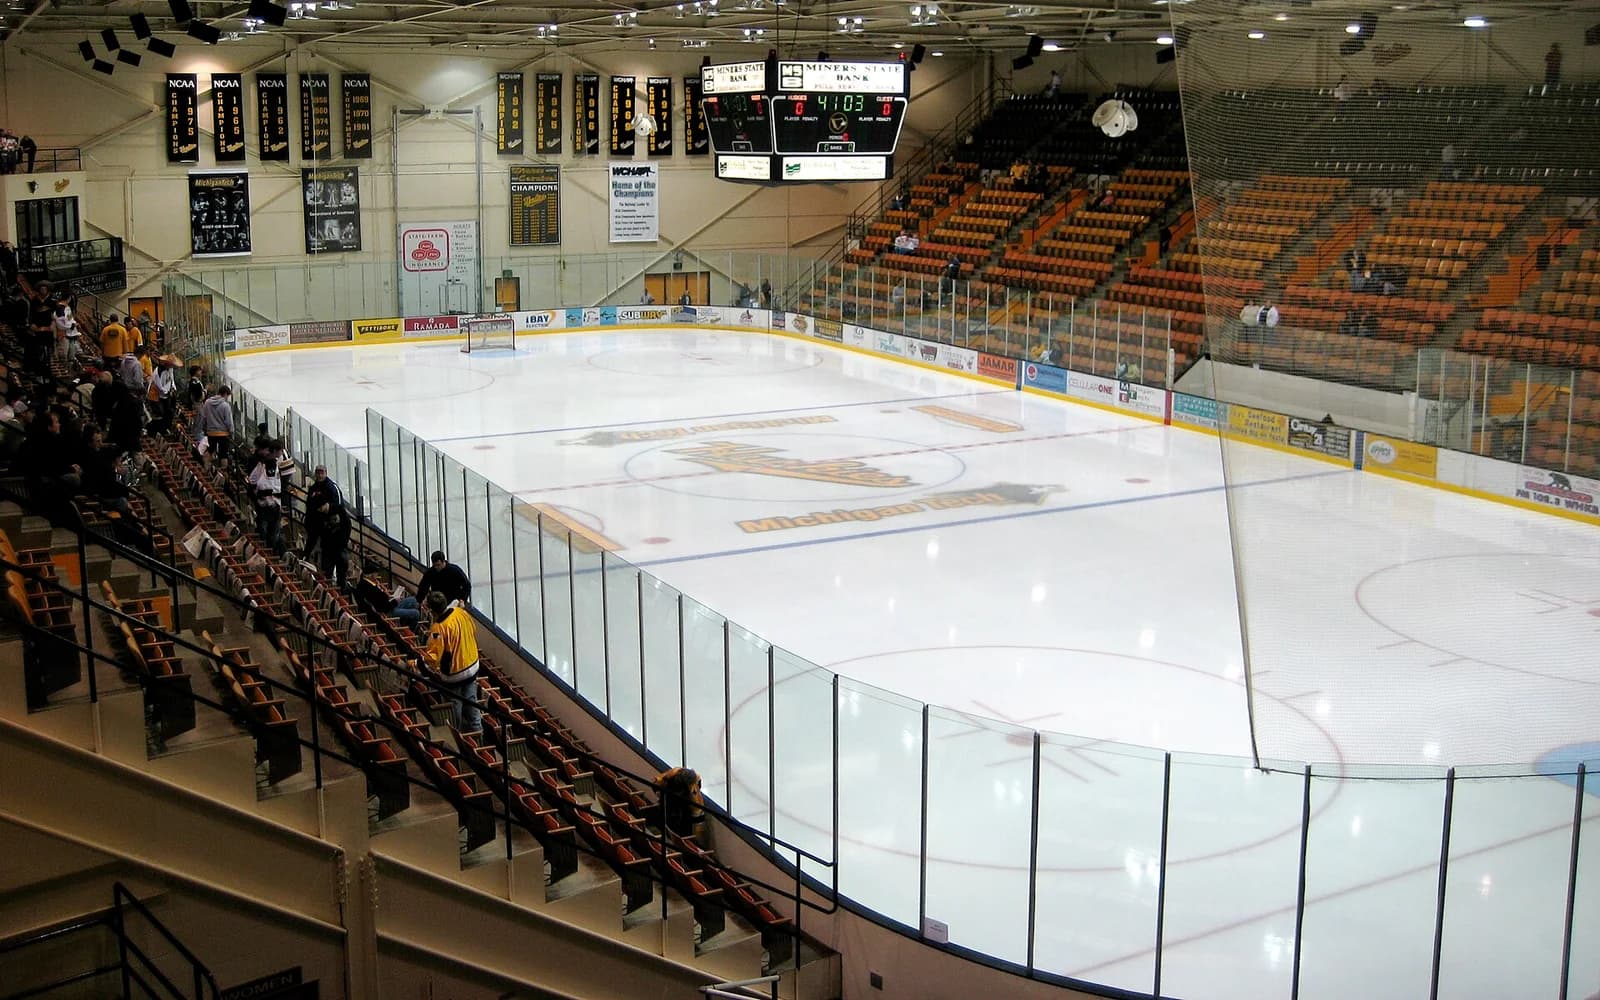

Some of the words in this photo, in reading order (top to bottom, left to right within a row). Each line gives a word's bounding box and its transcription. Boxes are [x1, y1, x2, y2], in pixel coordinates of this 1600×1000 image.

[745, 63, 764, 72] STATE
[806, 64, 857, 72] MINERS
[865, 65, 901, 73] STATE
[169, 80, 195, 88] NCAA
[213, 79, 239, 88] NCAA
[260, 80, 284, 88] NCAA
[232, 96, 240, 135] 1965
[612, 181, 633, 189] Home
[634, 181, 642, 191] of
[643, 181, 656, 189] the
[614, 190, 654, 198] Champions
[619, 310, 667, 320] SUBWAY
[981, 356, 1015, 373] JAMAR
[736, 502, 925, 534] Michigan
[924, 493, 1003, 511] Tech
